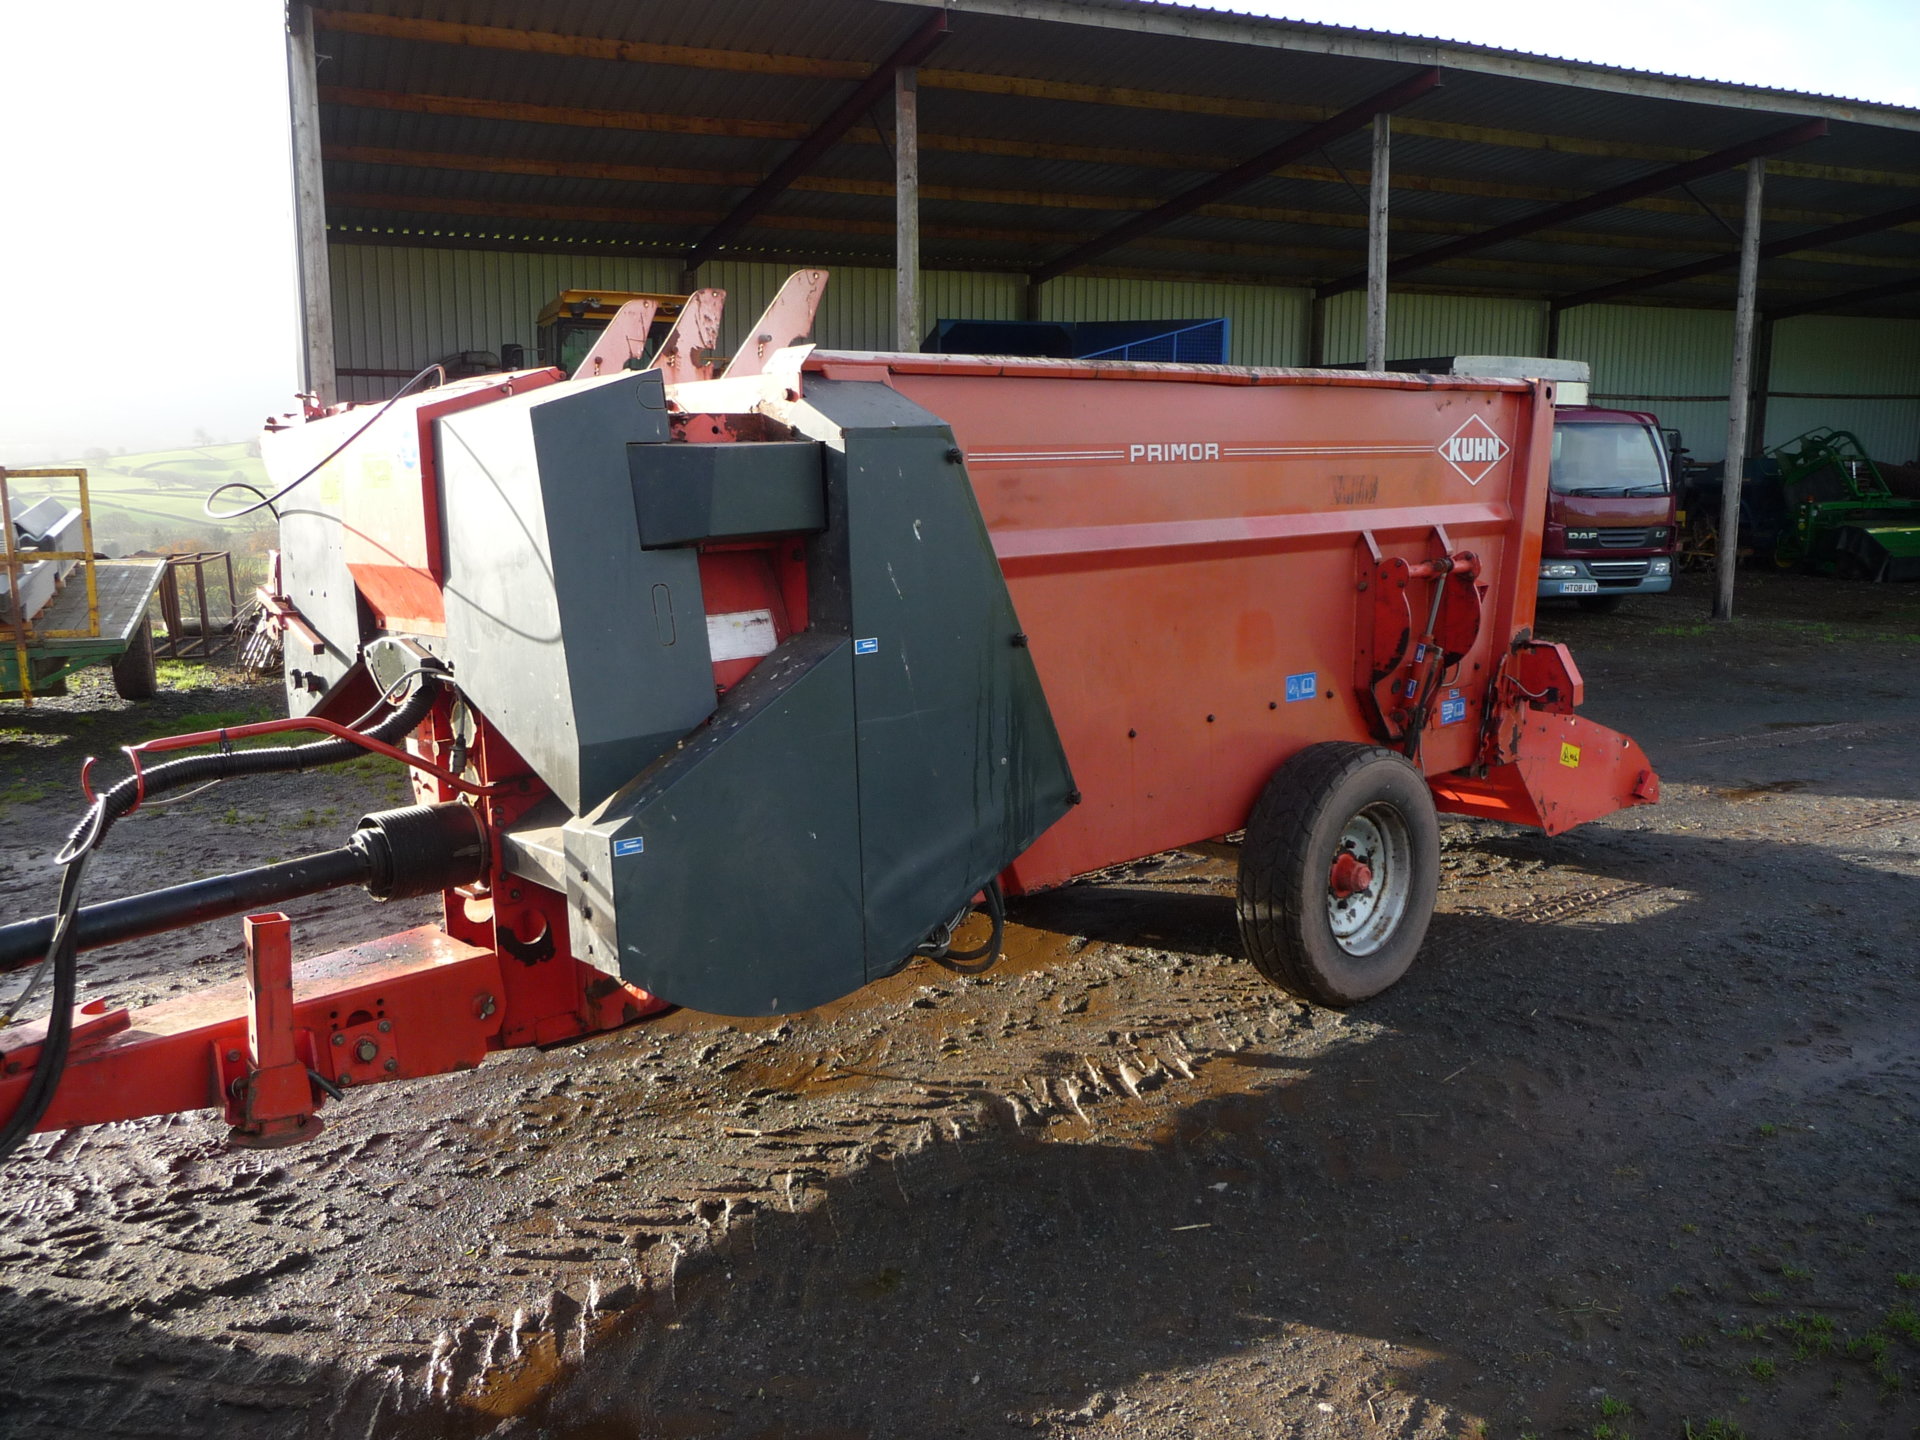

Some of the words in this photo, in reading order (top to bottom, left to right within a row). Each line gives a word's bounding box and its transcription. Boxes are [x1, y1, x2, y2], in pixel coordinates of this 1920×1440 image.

[1130, 443, 1220, 463] PRIMOR
[1449, 437, 1500, 462] KUHN
[1564, 584, 1583, 592] HT08
